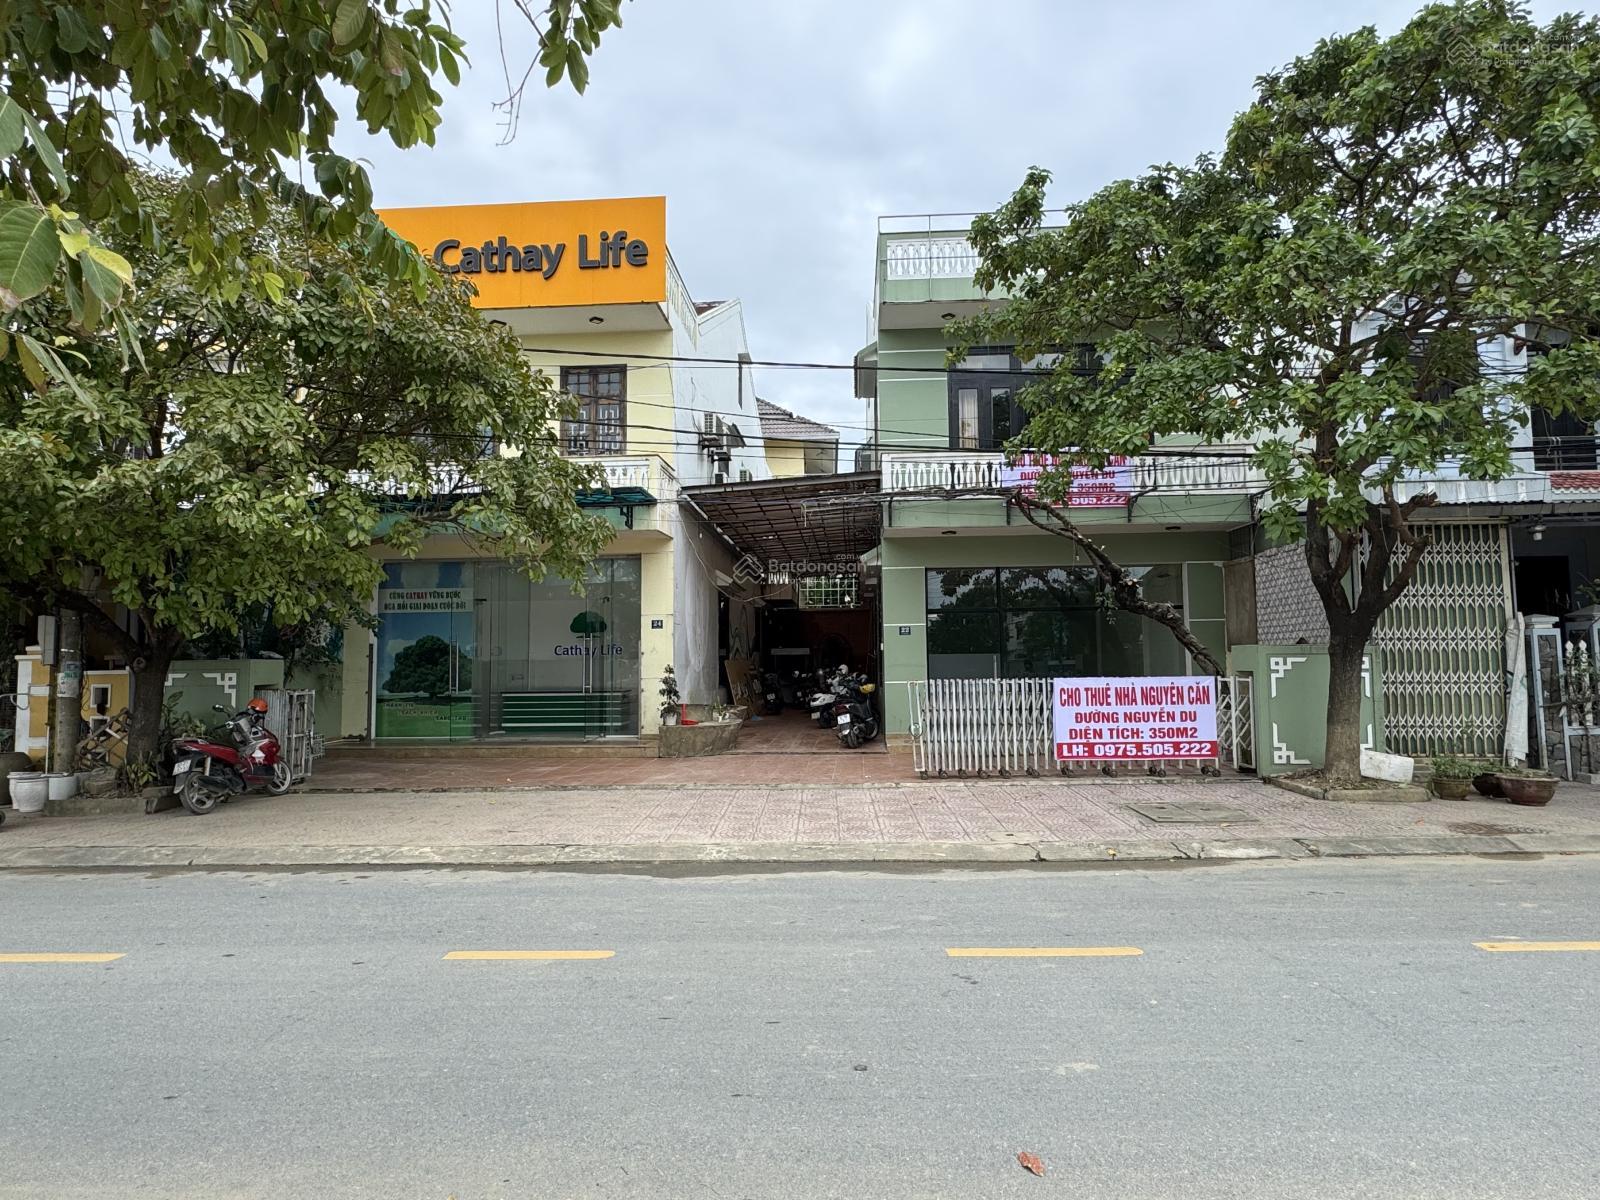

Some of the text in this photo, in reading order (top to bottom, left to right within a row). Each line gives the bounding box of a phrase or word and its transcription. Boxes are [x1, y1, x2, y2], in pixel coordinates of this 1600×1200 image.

[432, 231, 648, 280] Cathay Life
[554, 644, 623, 657] Cathay Life
[1059, 682, 1210, 707] CHO THUÊ NHÀ NGUYÊN CĂN
[1074, 706, 1197, 724] ĐƯỜNG NGUYỄN DU
[1069, 725, 1198, 743] DIỆN TÍCH: 350M2
[1062, 743, 1212, 757] LH: 0975.505.222
